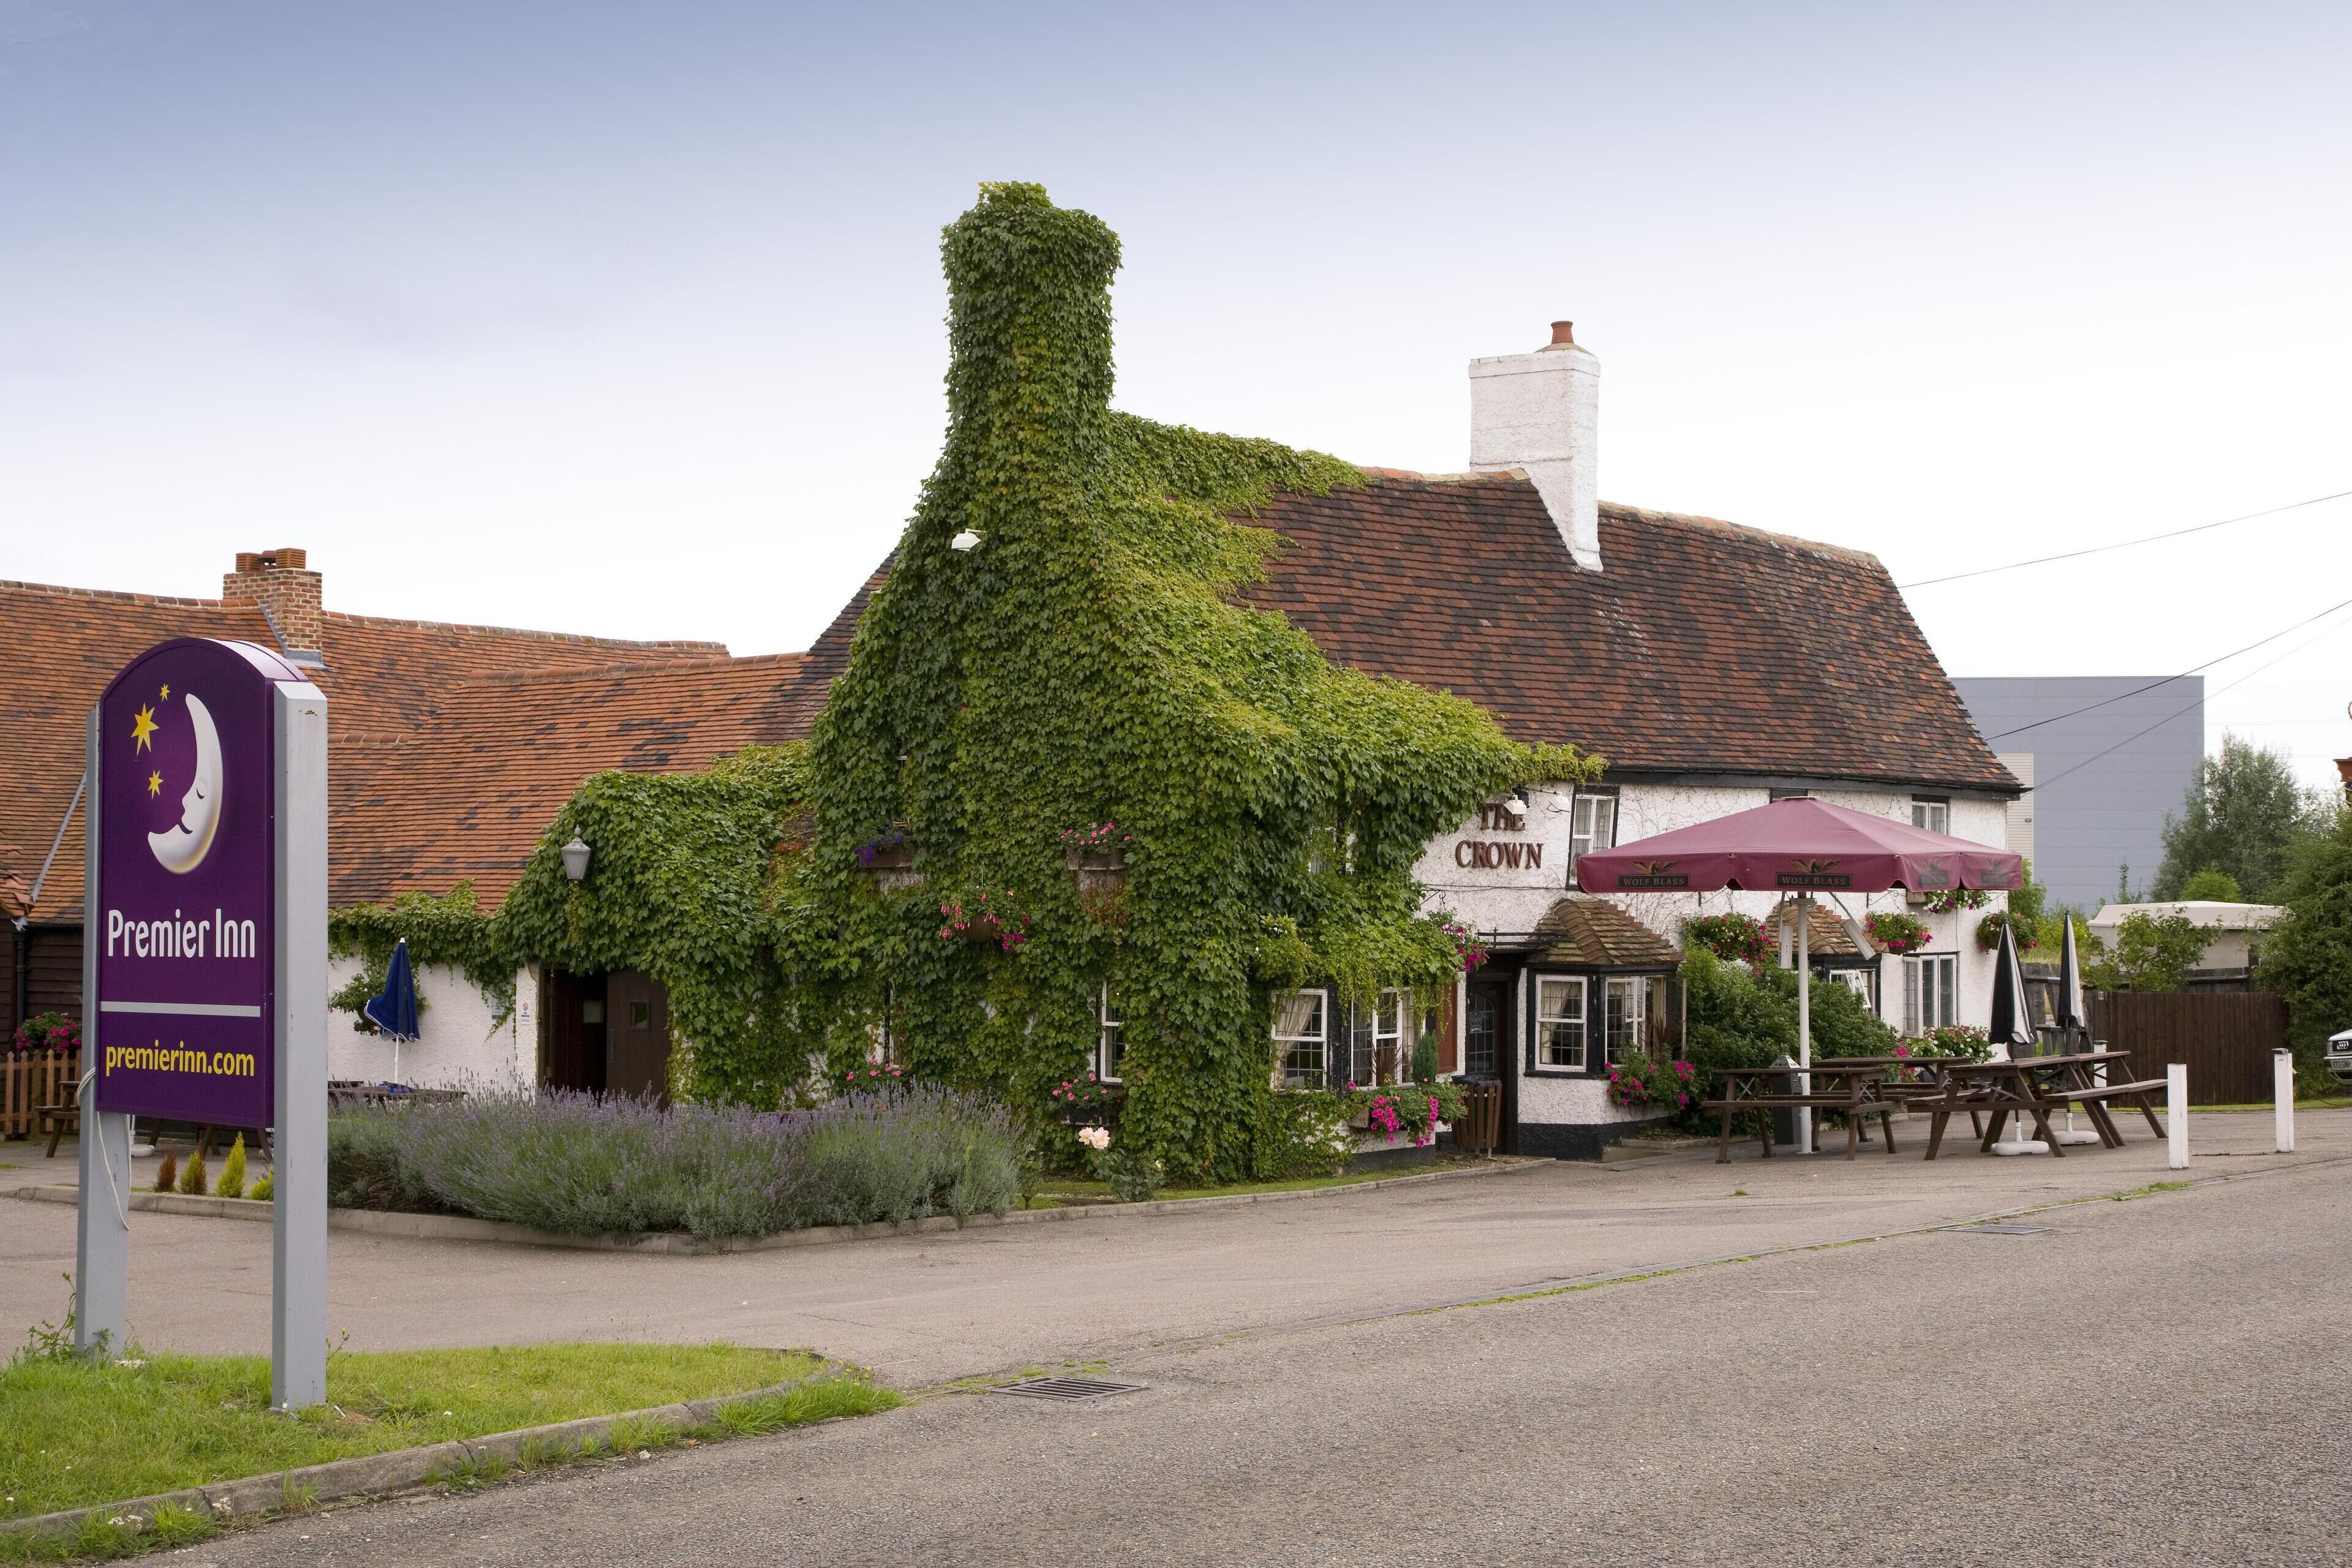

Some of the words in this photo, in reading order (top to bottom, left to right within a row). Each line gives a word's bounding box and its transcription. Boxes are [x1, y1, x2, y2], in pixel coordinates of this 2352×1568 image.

[1455, 840, 1544, 869] CROWN
[1814, 876, 1846, 885] BLASS
[108, 908, 209, 958] Premier
[216, 908, 255, 958] Inn
[105, 1039, 255, 1077] premierinn.com
